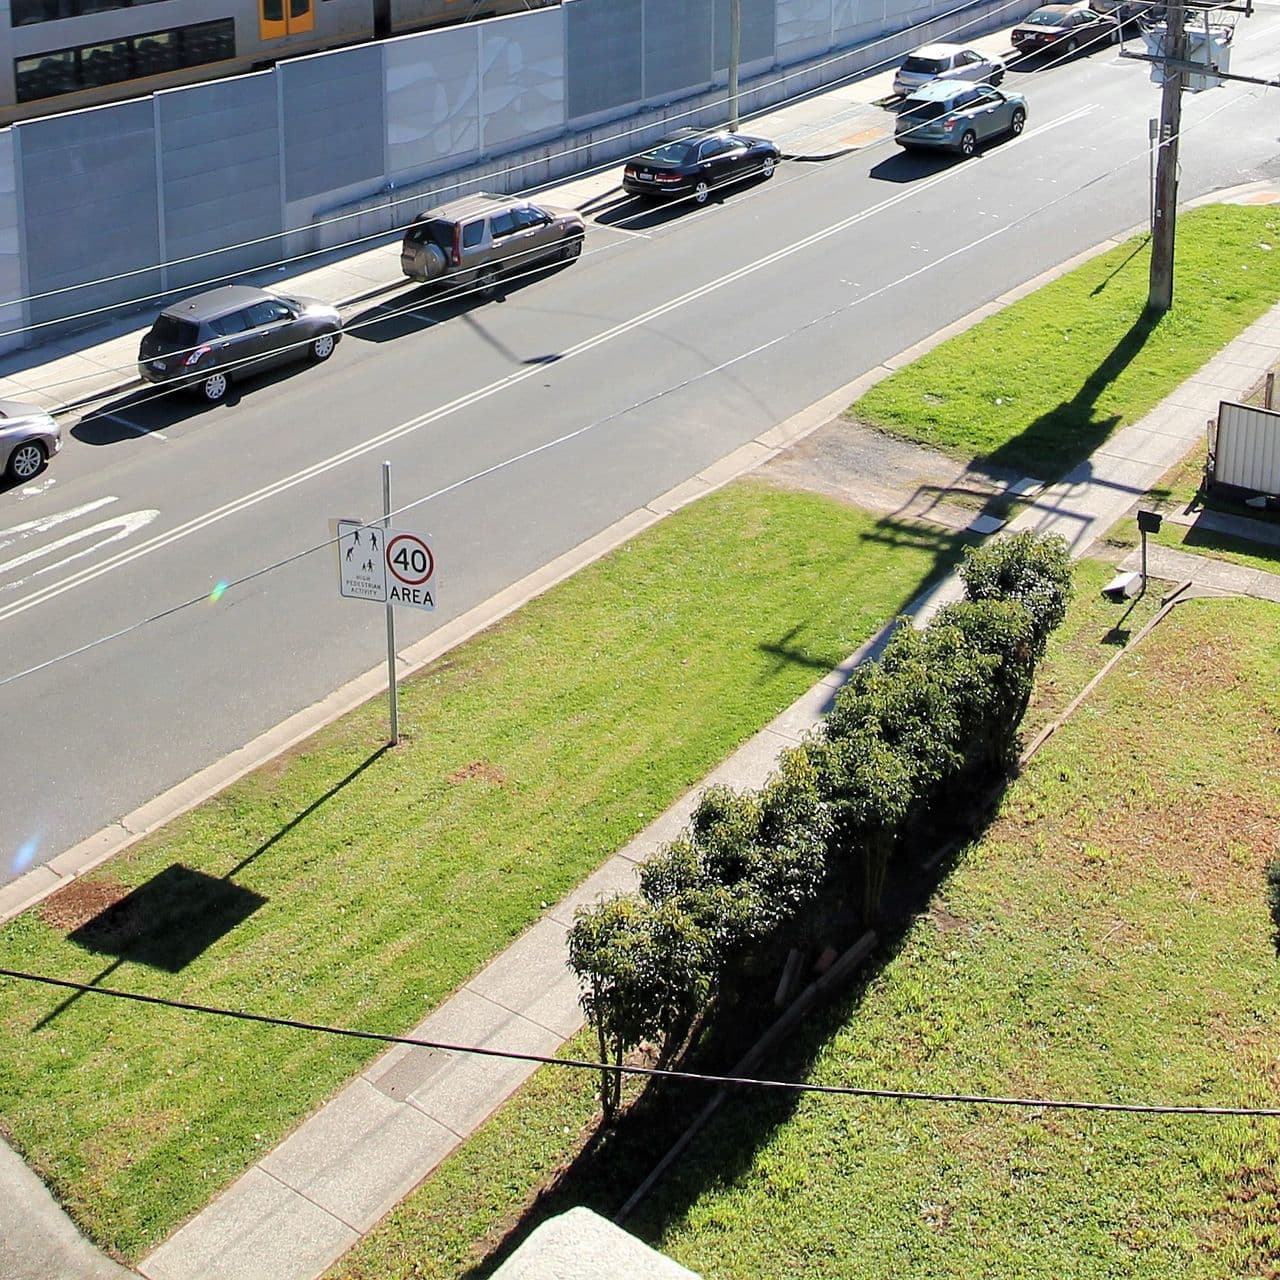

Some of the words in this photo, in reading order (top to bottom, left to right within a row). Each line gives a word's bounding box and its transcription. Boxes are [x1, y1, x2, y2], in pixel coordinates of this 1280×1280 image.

[393, 547, 426, 573] 40
[346, 580, 381, 589] PEDESTRIAN
[350, 588, 377, 596] ACTIVITY
[389, 585, 434, 606] AREA
